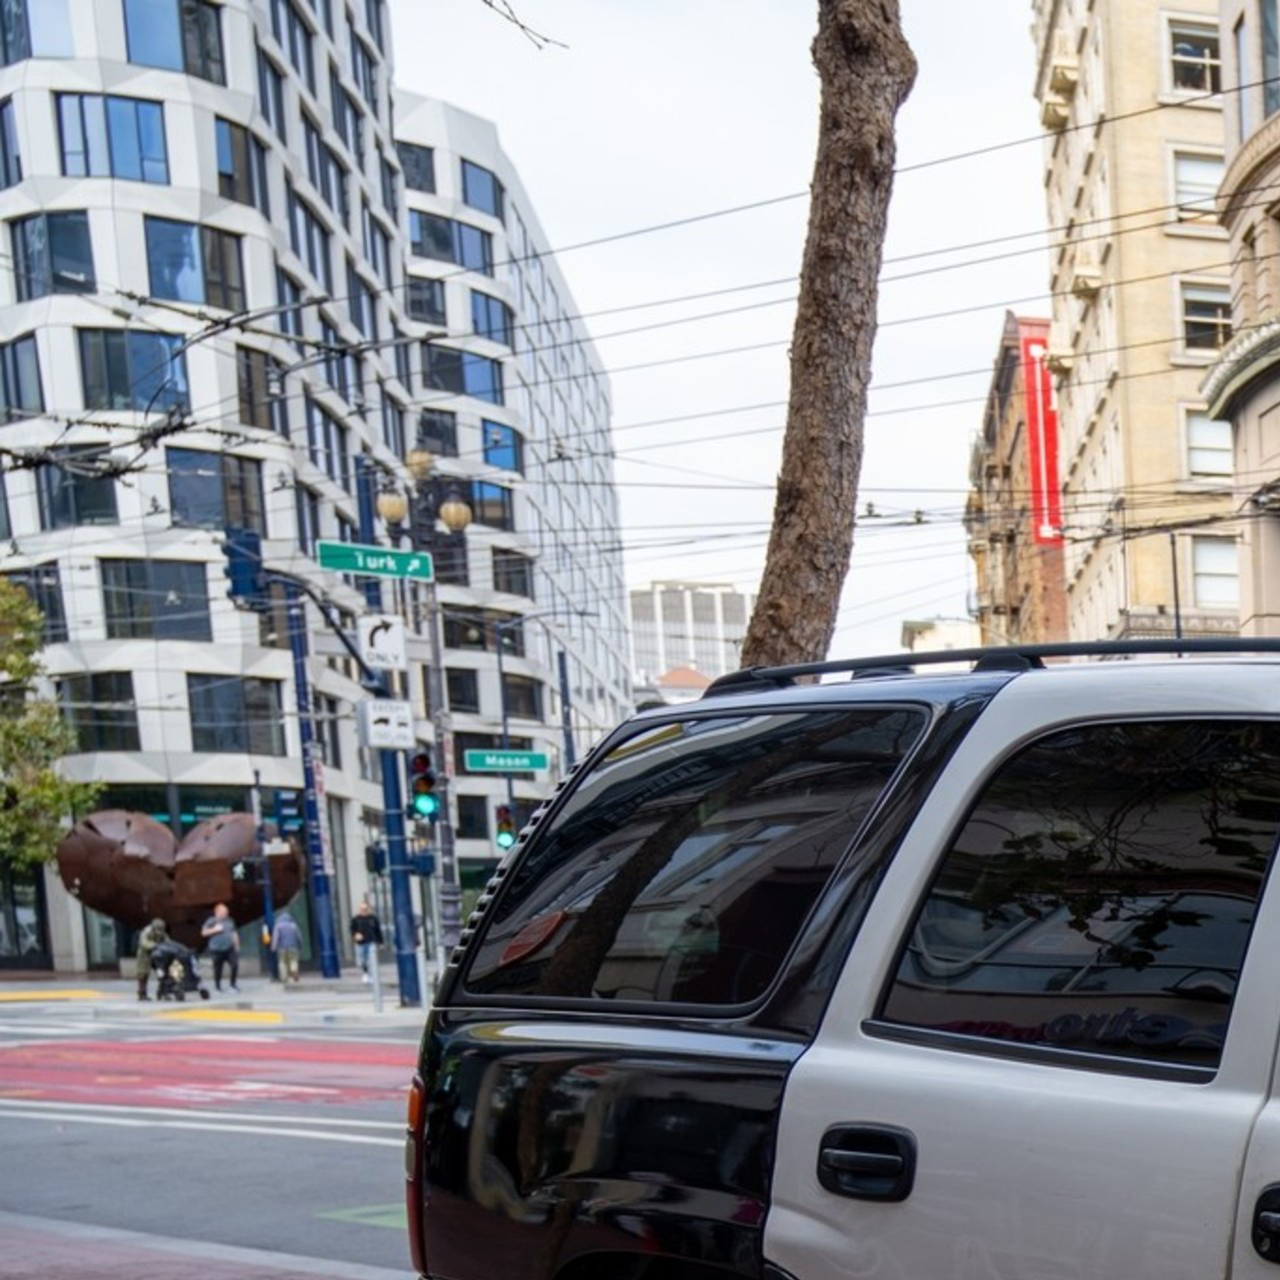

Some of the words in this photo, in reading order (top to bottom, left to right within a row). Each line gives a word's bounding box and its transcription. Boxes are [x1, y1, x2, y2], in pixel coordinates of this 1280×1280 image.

[354, 551, 397, 571] Turk
[366, 650, 399, 664] ONLY
[486, 755, 530, 767] Mason
